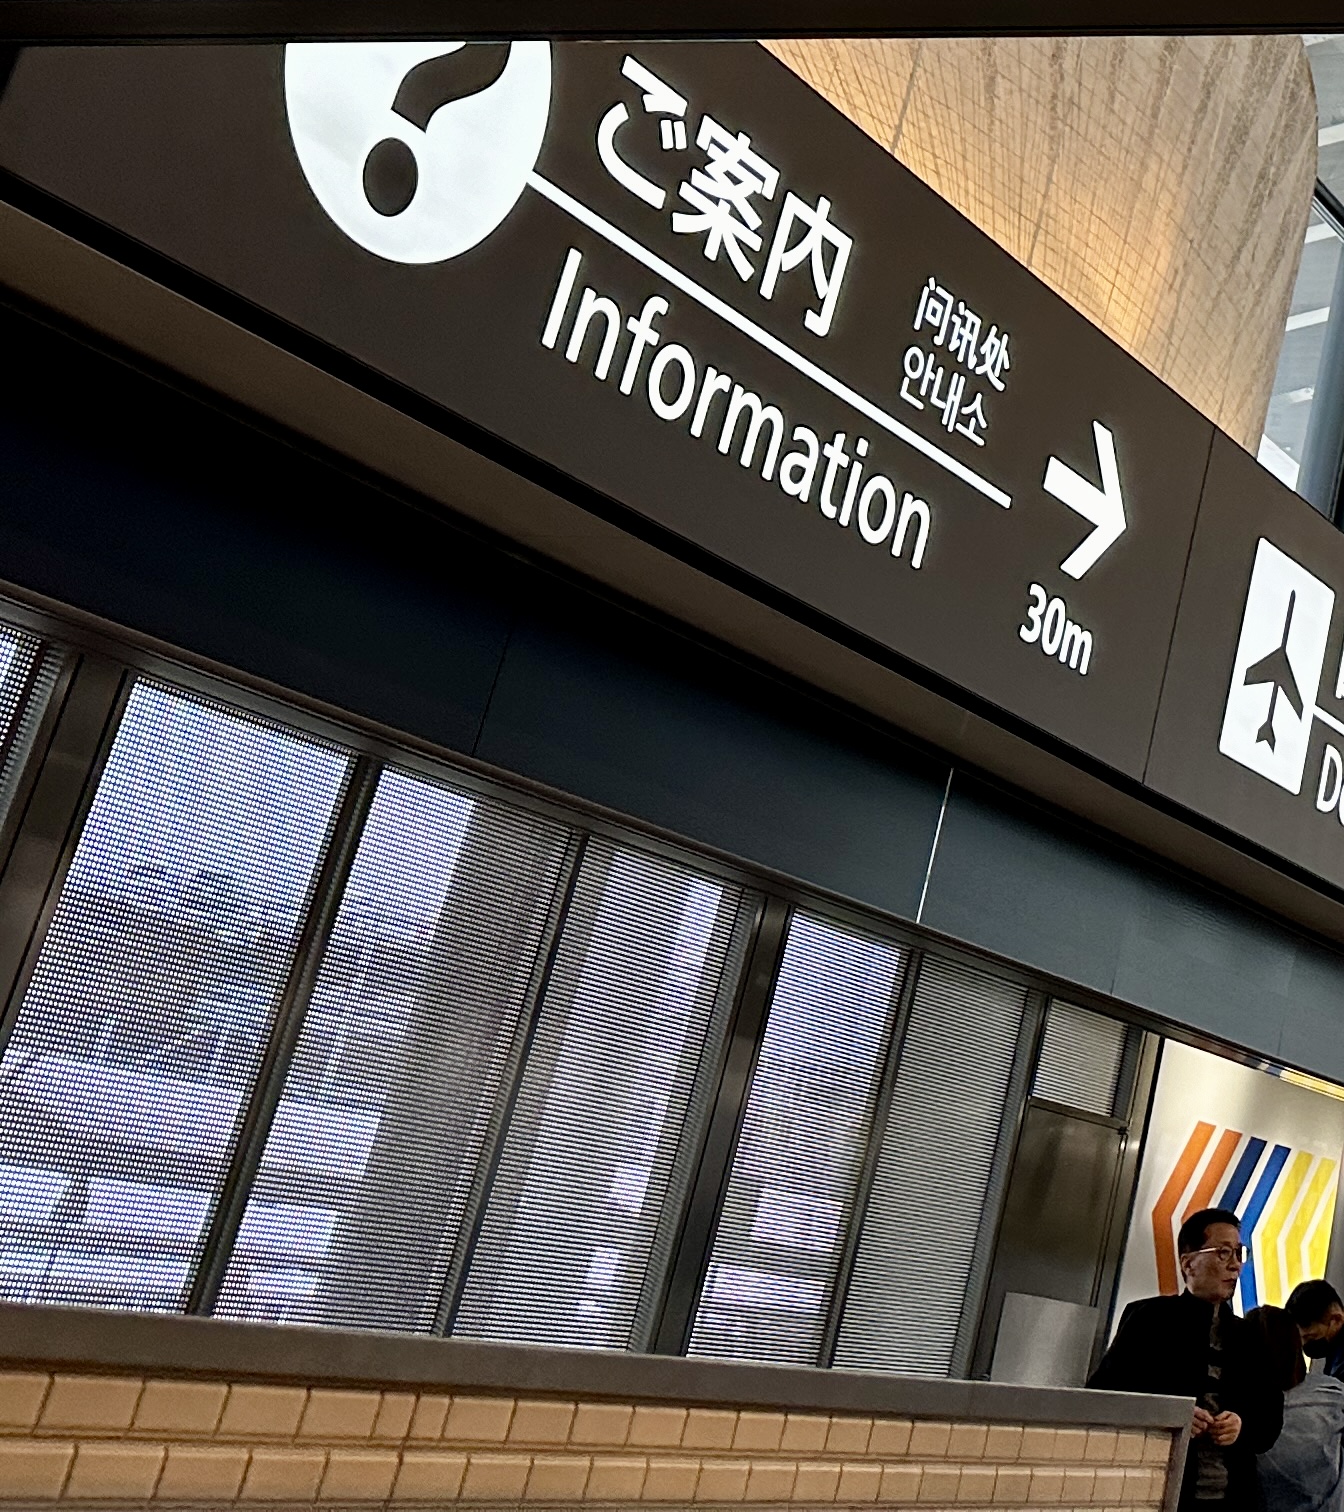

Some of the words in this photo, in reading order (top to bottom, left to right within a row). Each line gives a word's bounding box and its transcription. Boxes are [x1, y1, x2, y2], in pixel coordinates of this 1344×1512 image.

[598, 55, 853, 337] ご案内
[913, 276, 1010, 392] 问讯处
[541, 247, 931, 569] Information
[899, 346, 988, 446] 안내소
[1019, 584, 1093, 675] 30m
